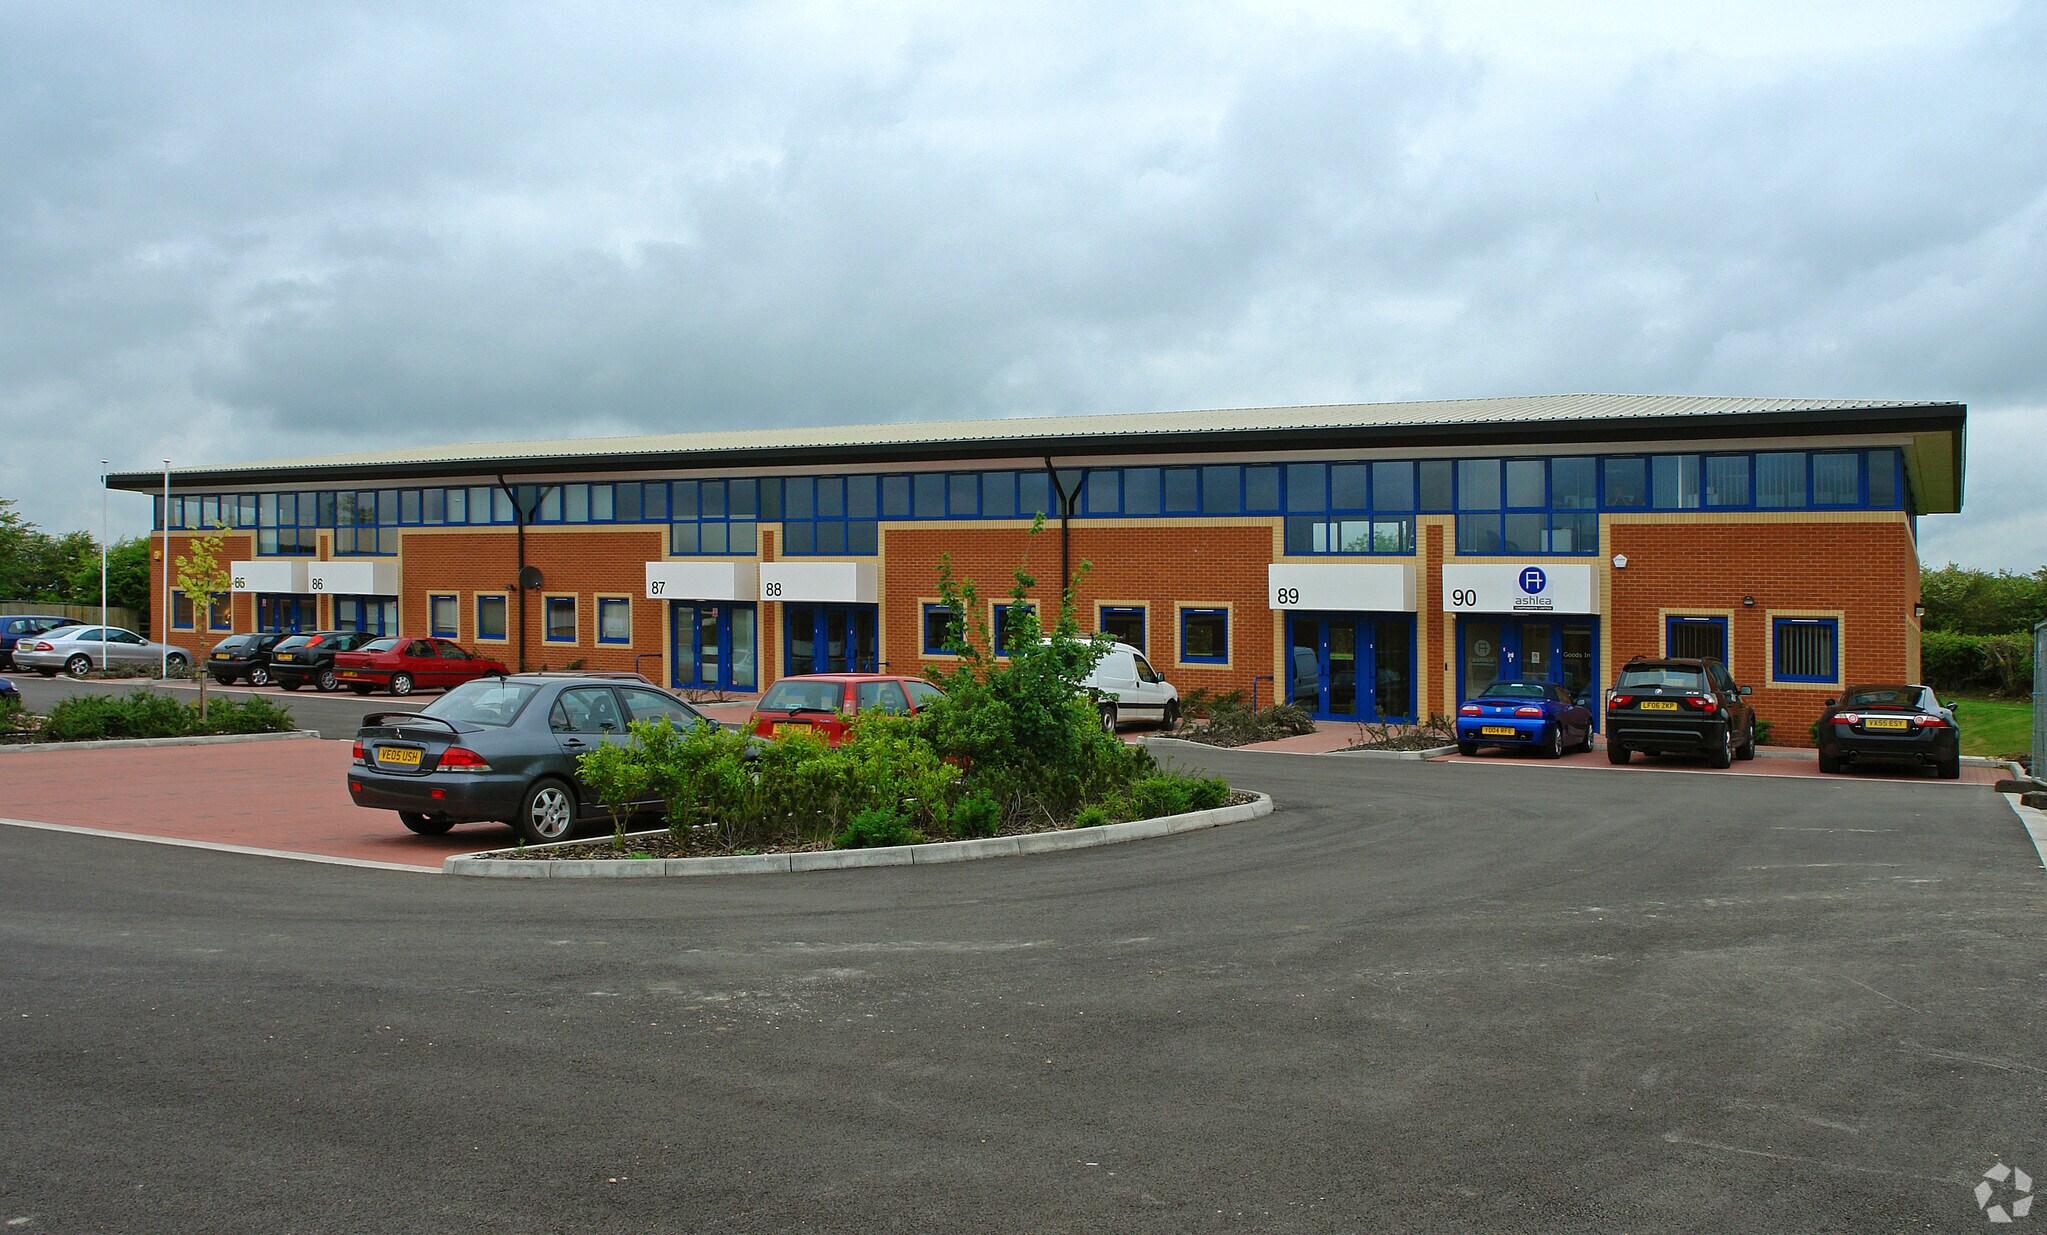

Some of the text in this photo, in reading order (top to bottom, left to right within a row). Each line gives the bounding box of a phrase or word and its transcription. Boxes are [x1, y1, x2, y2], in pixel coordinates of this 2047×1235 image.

[312, 578, 323, 590] 86
[651, 581, 666, 595] 87
[765, 582, 782, 597] 88
[1277, 588, 1300, 605] 89
[1451, 589, 1477, 607] 90
[1515, 595, 1552, 605] ashlea
[1563, 651, 1583, 659] Goods
[382, 748, 418, 763] VE05 USH
